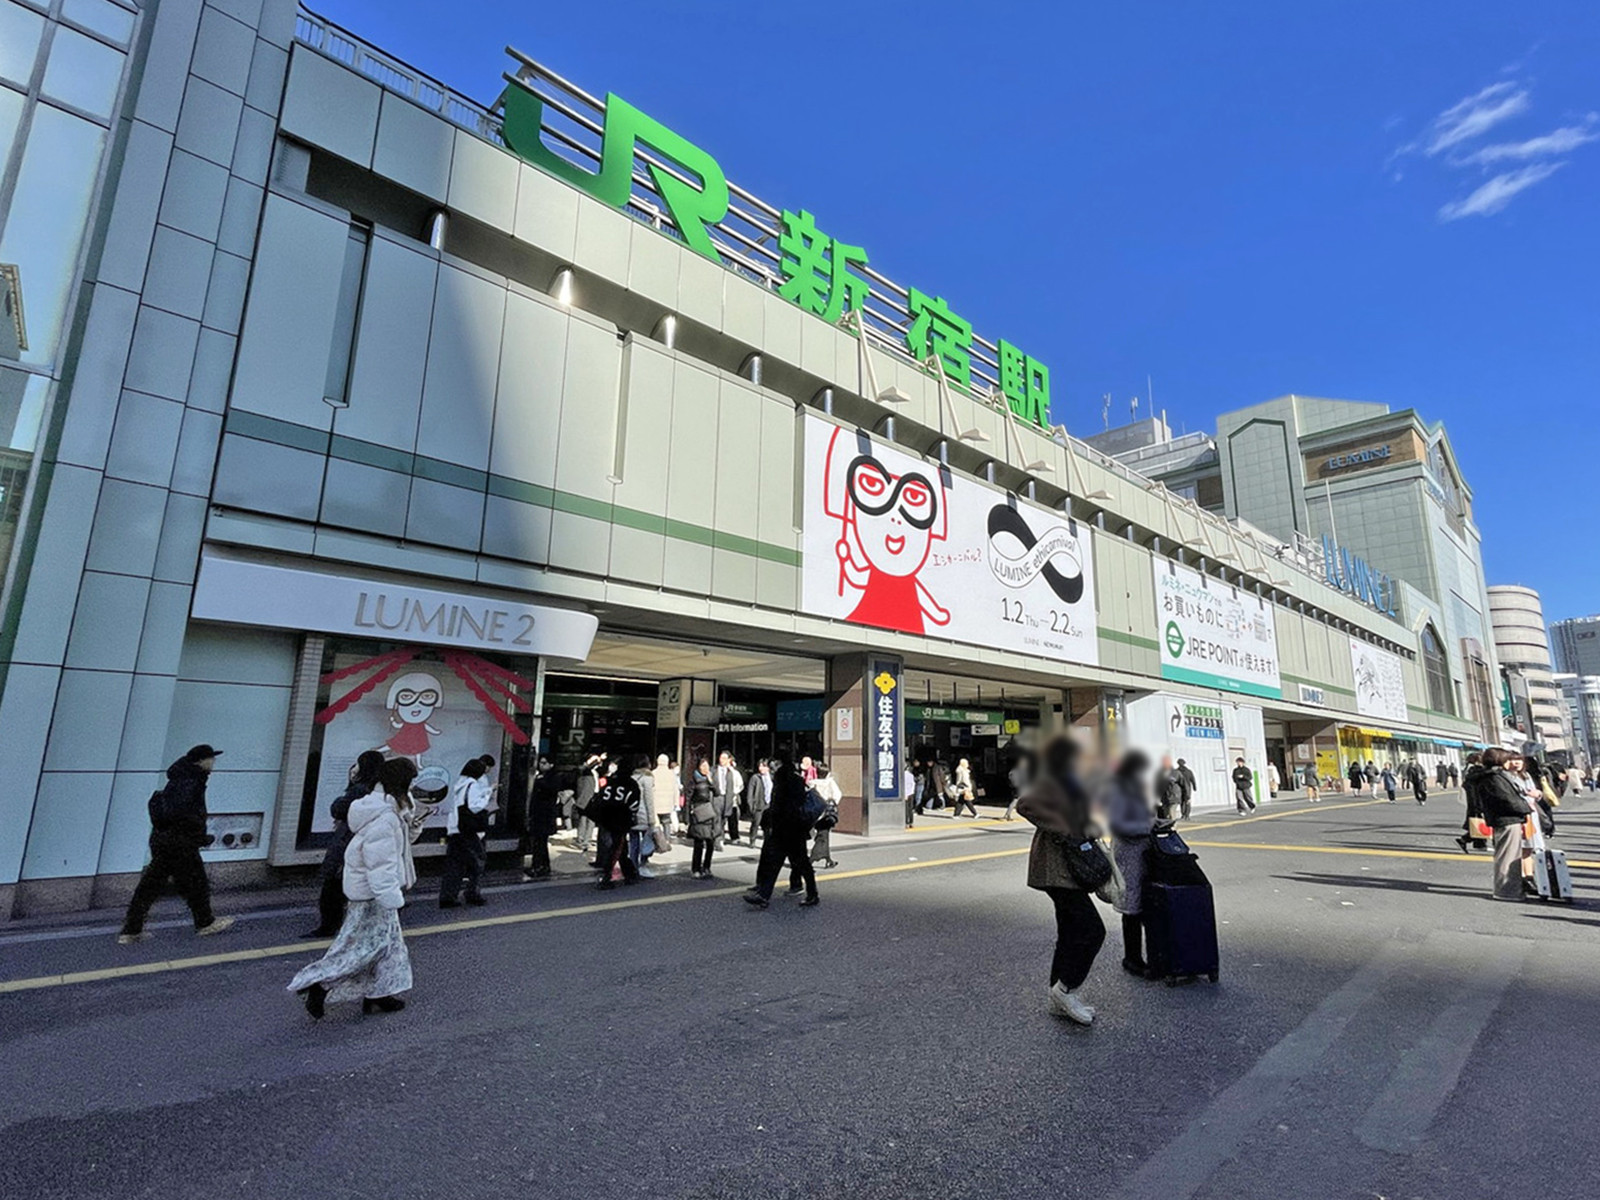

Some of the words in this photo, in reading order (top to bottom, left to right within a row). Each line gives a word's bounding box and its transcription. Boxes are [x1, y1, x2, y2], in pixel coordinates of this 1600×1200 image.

[503, 84, 729, 263] JR
[778, 209, 1050, 431] 新宿駅
[994, 557, 1033, 582] LUMINE
[1033, 534, 1076, 569] ethicarnival
[354, 592, 509, 642] LUMINE
[511, 614, 536, 646] 2
[1163, 592, 1224, 628] お買いものに
[1186, 636, 1208, 660] JRE
[558, 729, 586, 746] JR
[730, 723, 768, 732] Information
[878, 695, 894, 790] 住友不動産
